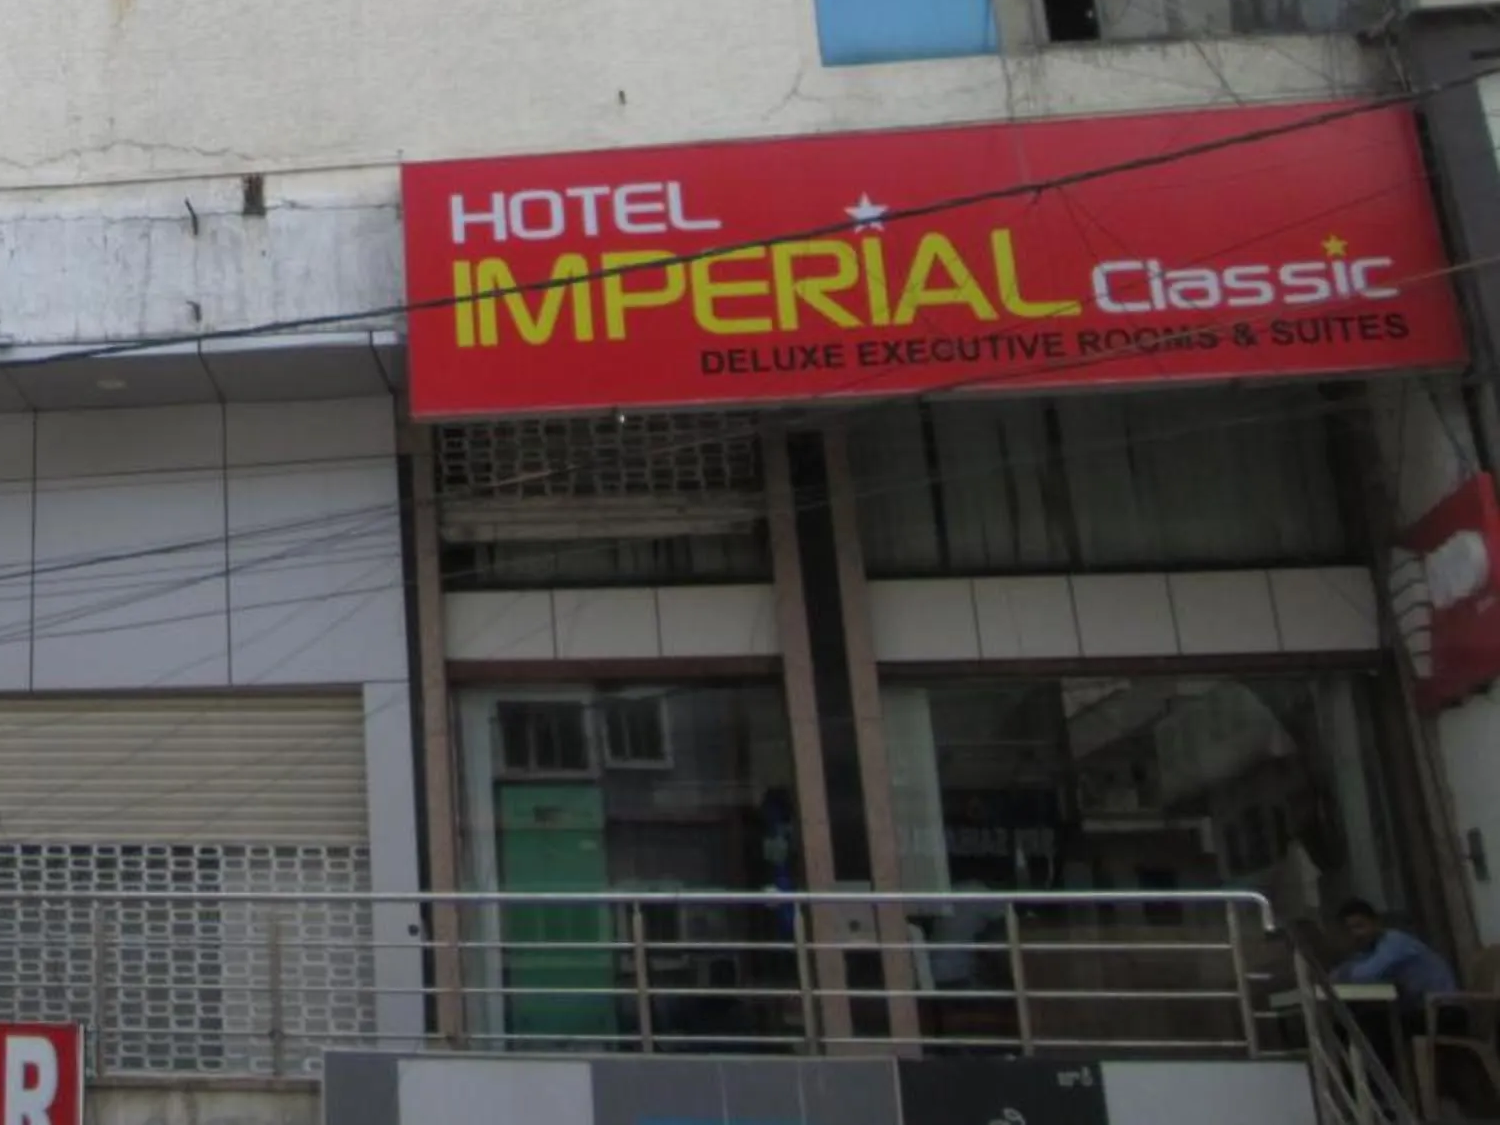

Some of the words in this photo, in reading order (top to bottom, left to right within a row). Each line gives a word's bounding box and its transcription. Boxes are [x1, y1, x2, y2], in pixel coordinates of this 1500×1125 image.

[450, 181, 722, 243] HOTEL
[454, 228, 1082, 348] IMPERIAL
[1092, 237, 1398, 313] Classic
[700, 343, 845, 375] DELUXE
[857, 331, 1066, 368] EXECUTIVE
[1078, 324, 1219, 358] ROOMS
[1232, 320, 1259, 347] &
[1271, 312, 1410, 347] SUITES
